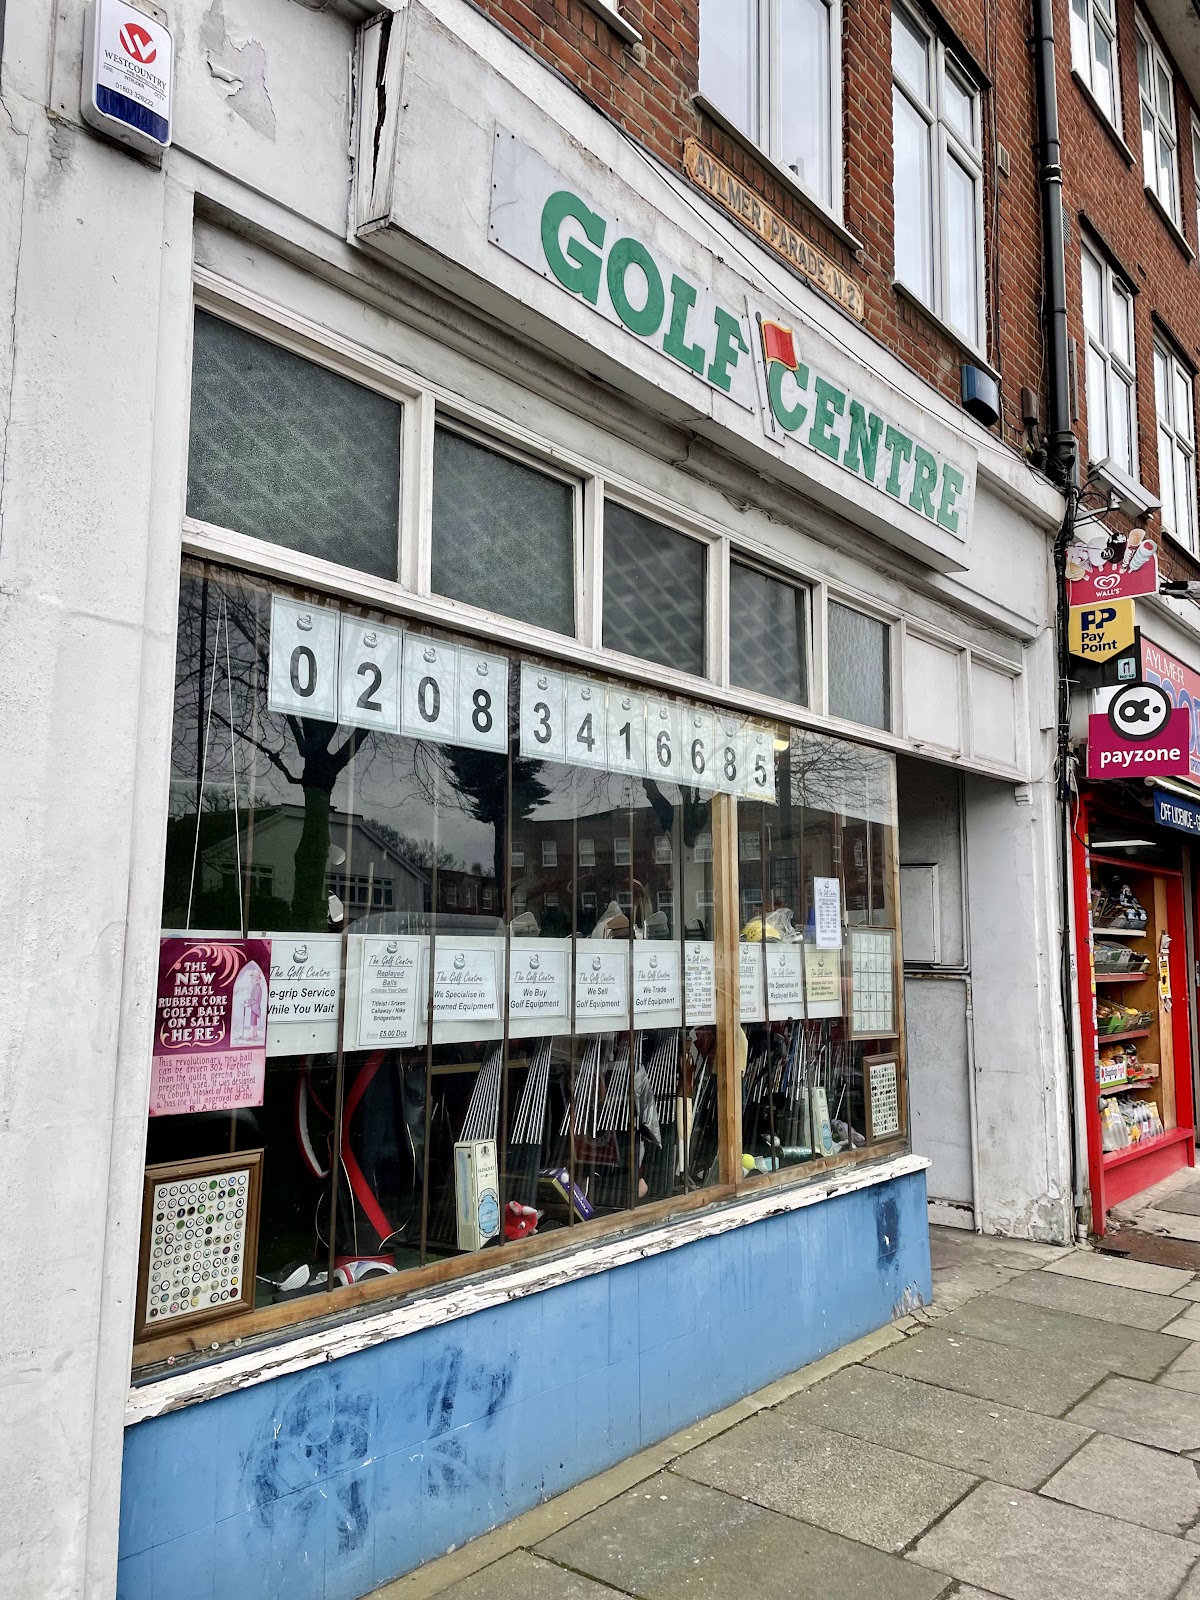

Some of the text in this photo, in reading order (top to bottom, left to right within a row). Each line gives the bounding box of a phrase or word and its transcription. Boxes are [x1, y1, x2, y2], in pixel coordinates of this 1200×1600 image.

[105, 50, 166, 90] WESTCOUNTRY
[125, 75, 144, 89] INTRUDER
[695, 152, 761, 230] AYLMER
[541, 191, 964, 533] GOLF CENTRE
[1096, 588, 1121, 597] WALL'S
[1082, 632, 1105, 643] Pay
[1082, 640, 1117, 653] Point
[1146, 647, 1185, 686] AYLMER
[1100, 747, 1181, 768] payzone
[1160, 802, 1171, 821] OFF
[184, 962, 207, 972] THE
[369, 955, 413, 967] The Golf Centre
[175, 972, 216, 986] NEW
[270, 966, 330, 981] The Golf Centre
[436, 971, 483, 985] The Golf Centre
[515, 971, 555, 984] The Golf Centre
[580, 973, 615, 985] The Golf Centre
[174, 986, 214, 996] HASKEL
[270, 988, 335, 1000] e-grip Service
[445, 991, 477, 999] Specialise
[534, 989, 547, 998] Buy
[158, 996, 227, 1008] RUBBER CORE
[293, 1004, 310, 1013] You
[314, 1003, 334, 1013] Wait
[459, 1003, 494, 1011] Equipment
[510, 1000, 559, 1009] Golf Equipment
[576, 1000, 620, 1009] Golf Equipment
[636, 997, 674, 1006] Golf Equipment
[162, 1006, 226, 1018] GOLF BALL
[168, 1016, 220, 1028] ON SALE
[170, 1028, 218, 1042] HERE.
[159, 1051, 253, 1067] This revolutionary new ball
[158, 1062, 250, 1075] can be driven 30% further
[158, 1068, 251, 1083] than the gutta percha ball
[158, 1082, 189, 1093] presently
[218, 1079, 230, 1087] was
[232, 1076, 256, 1086] designed
[157, 1093, 166, 1101] by
[167, 1090, 191, 1098] Coburn
[193, 1088, 214, 1097] Haskel
[216, 1087, 222, 1095] of
[223, 1086, 233, 1094] the
[156, 1101, 162, 1109] &
[164, 1099, 176, 1107] has
[177, 1098, 187, 1106] the
[190, 1096, 201, 1105] full
[204, 1094, 232, 1105] approval
[242, 1092, 253, 1100] the
